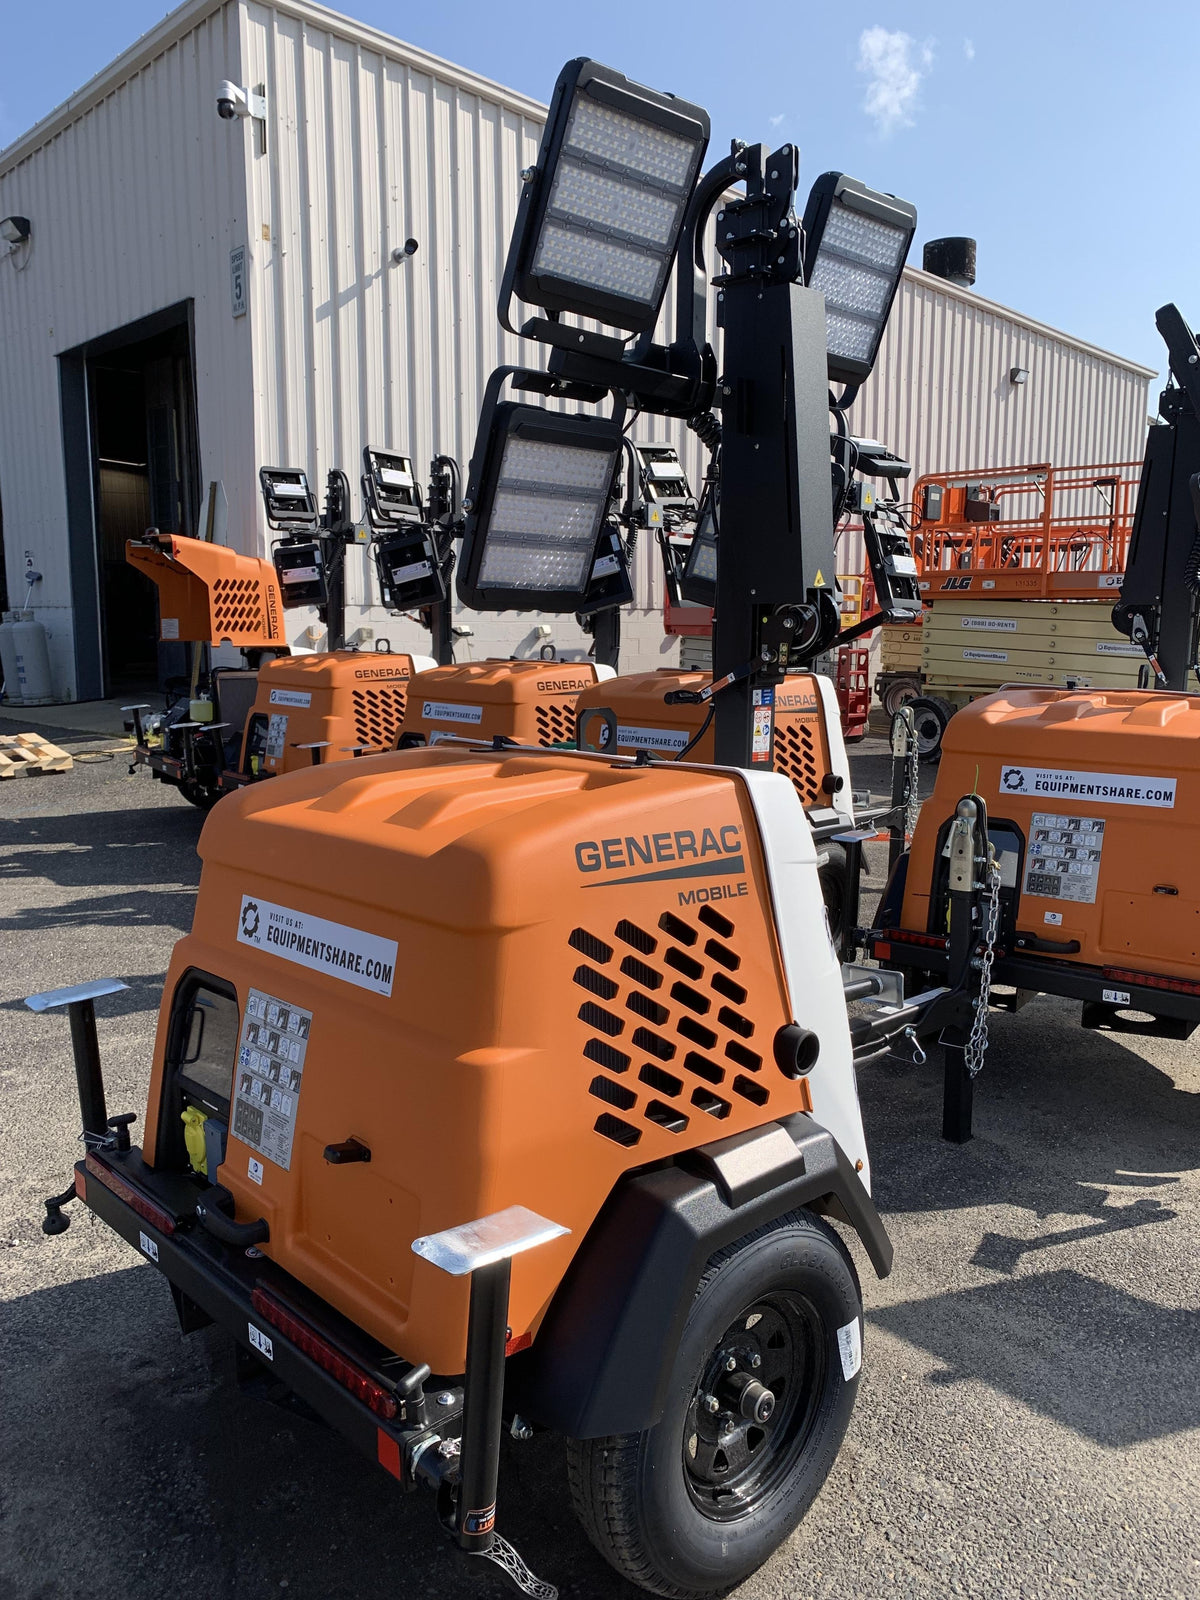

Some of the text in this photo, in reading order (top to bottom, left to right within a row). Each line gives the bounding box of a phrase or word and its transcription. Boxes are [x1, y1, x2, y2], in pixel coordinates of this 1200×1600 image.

[231, 252, 243, 264] SPEED
[235, 274, 242, 300] 5
[940, 576, 973, 590] JLG
[267, 585, 279, 639] GENERAC
[355, 668, 409, 679] GENERAC
[537, 680, 591, 691] GENERAC
[434, 709, 481, 720] EQUIPMENTSHARE.COM
[618, 734, 687, 748] EQUIPMENTSHARE.COM
[1035, 780, 1173, 802] EQUIPMENTSHARE.COM
[575, 825, 742, 872] GENERAC
[678, 882, 748, 906] MOBILE
[270, 912, 304, 929] VISIT US AT:
[266, 925, 393, 984] EQUIPMENTSHARE.COM
